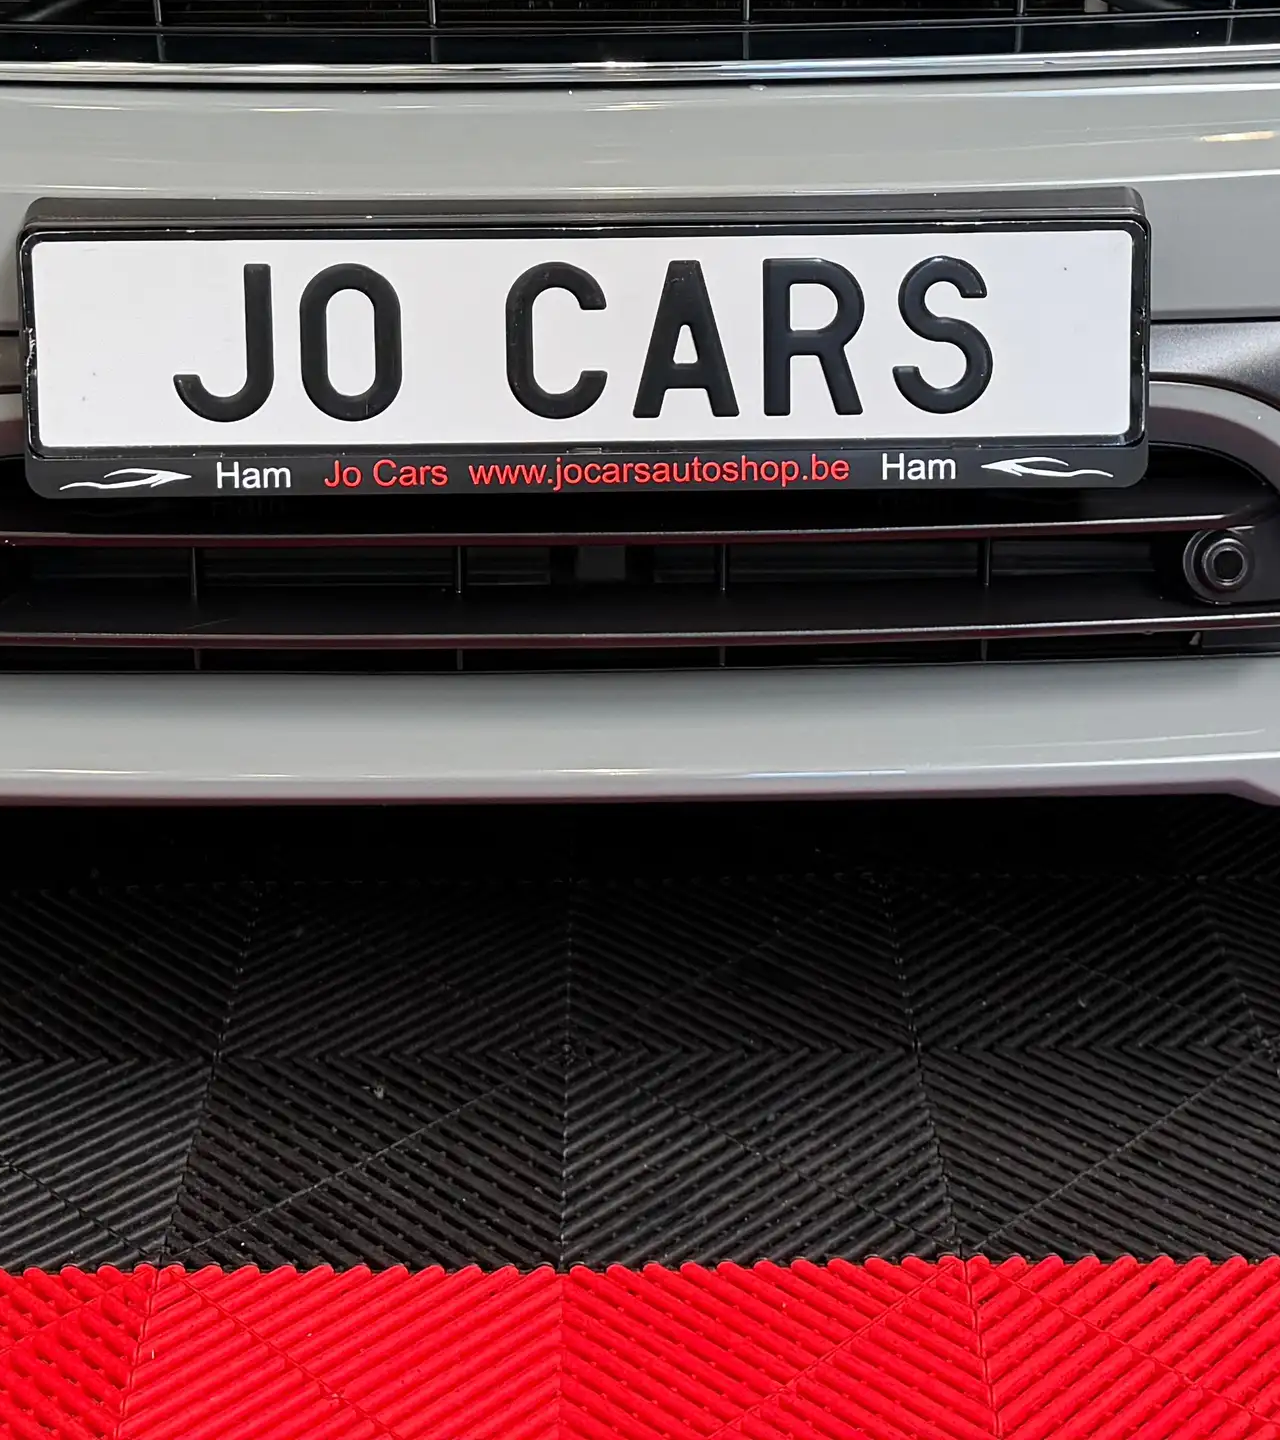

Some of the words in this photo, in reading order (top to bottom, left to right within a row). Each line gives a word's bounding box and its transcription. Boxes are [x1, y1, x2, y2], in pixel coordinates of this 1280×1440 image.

[173, 263, 402, 422] JO
[506, 256, 993, 420] CARS
[217, 461, 291, 489] Ham
[324, 460, 362, 488] Jo
[373, 459, 449, 487] Cars
[469, 453, 850, 491] www.jocarsautoshop.be
[882, 452, 956, 481] Ham
